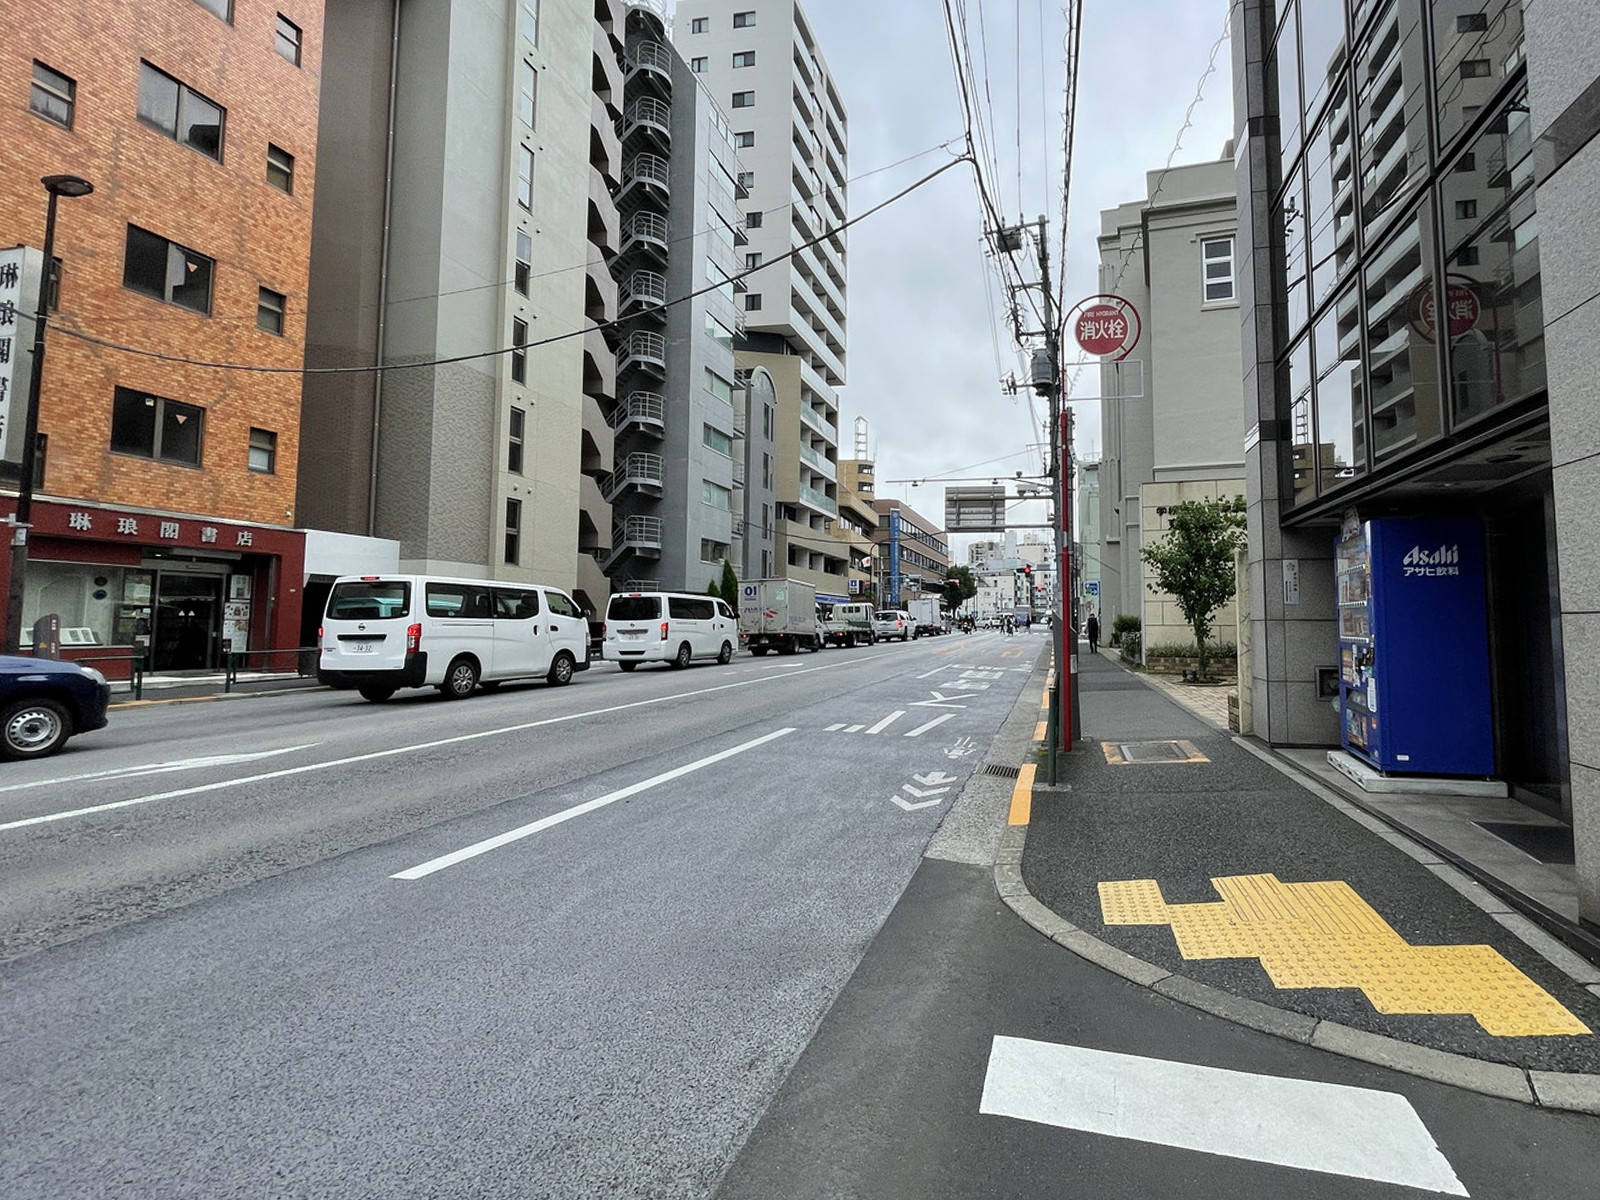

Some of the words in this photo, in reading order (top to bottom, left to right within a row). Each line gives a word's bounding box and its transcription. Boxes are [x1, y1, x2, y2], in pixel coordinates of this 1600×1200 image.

[1096, 310, 1119, 318] HYDRANT
[1080, 319, 1125, 341] 消火栓
[69, 512, 253, 547] 琳琅閣書店
[1403, 544, 1459, 566] Asahi
[1403, 566, 1459, 577] アサヒ飲料
[744, 585, 757, 597] 01
